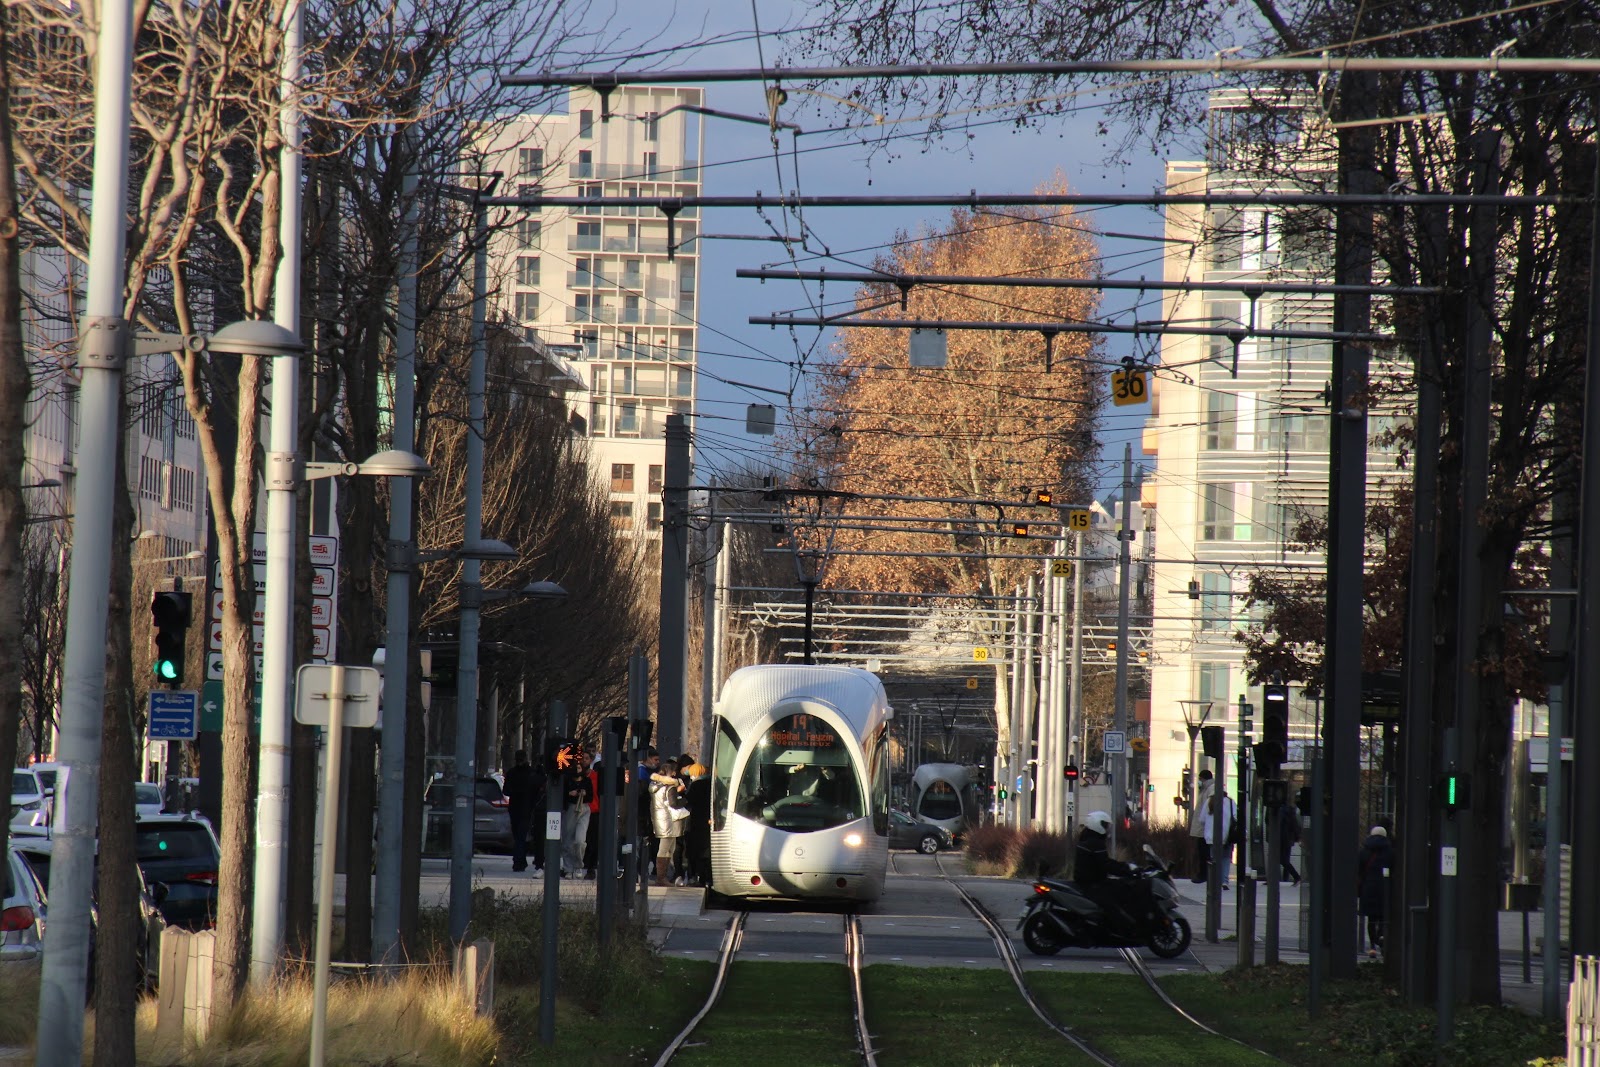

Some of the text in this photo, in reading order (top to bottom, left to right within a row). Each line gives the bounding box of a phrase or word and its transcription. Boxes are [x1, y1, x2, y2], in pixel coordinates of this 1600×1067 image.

[1116, 377, 1144, 398] 30
[1071, 514, 1088, 527] 15
[1054, 563, 1070, 574] 25
[975, 650, 986, 659] 30
